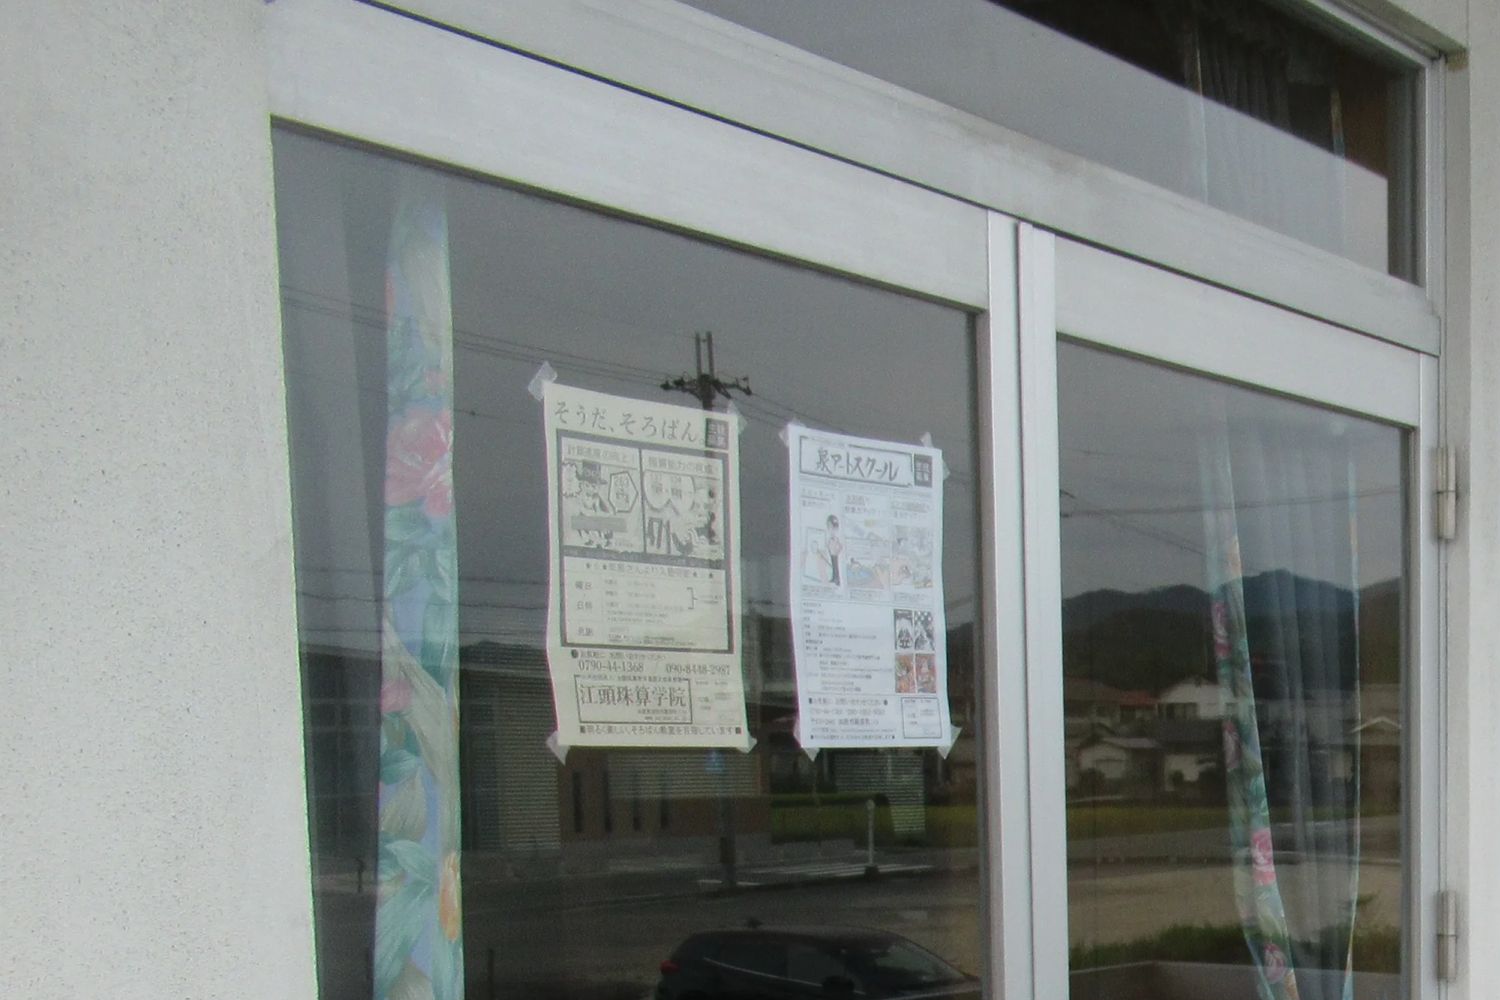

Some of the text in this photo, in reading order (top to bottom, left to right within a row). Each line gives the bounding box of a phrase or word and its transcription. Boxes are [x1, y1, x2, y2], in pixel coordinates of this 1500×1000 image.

[815, 447, 899, 482] 泉アートスクール
[578, 660, 645, 673] 0790-44-1368
[579, 684, 687, 707] 江頭珠算学院
